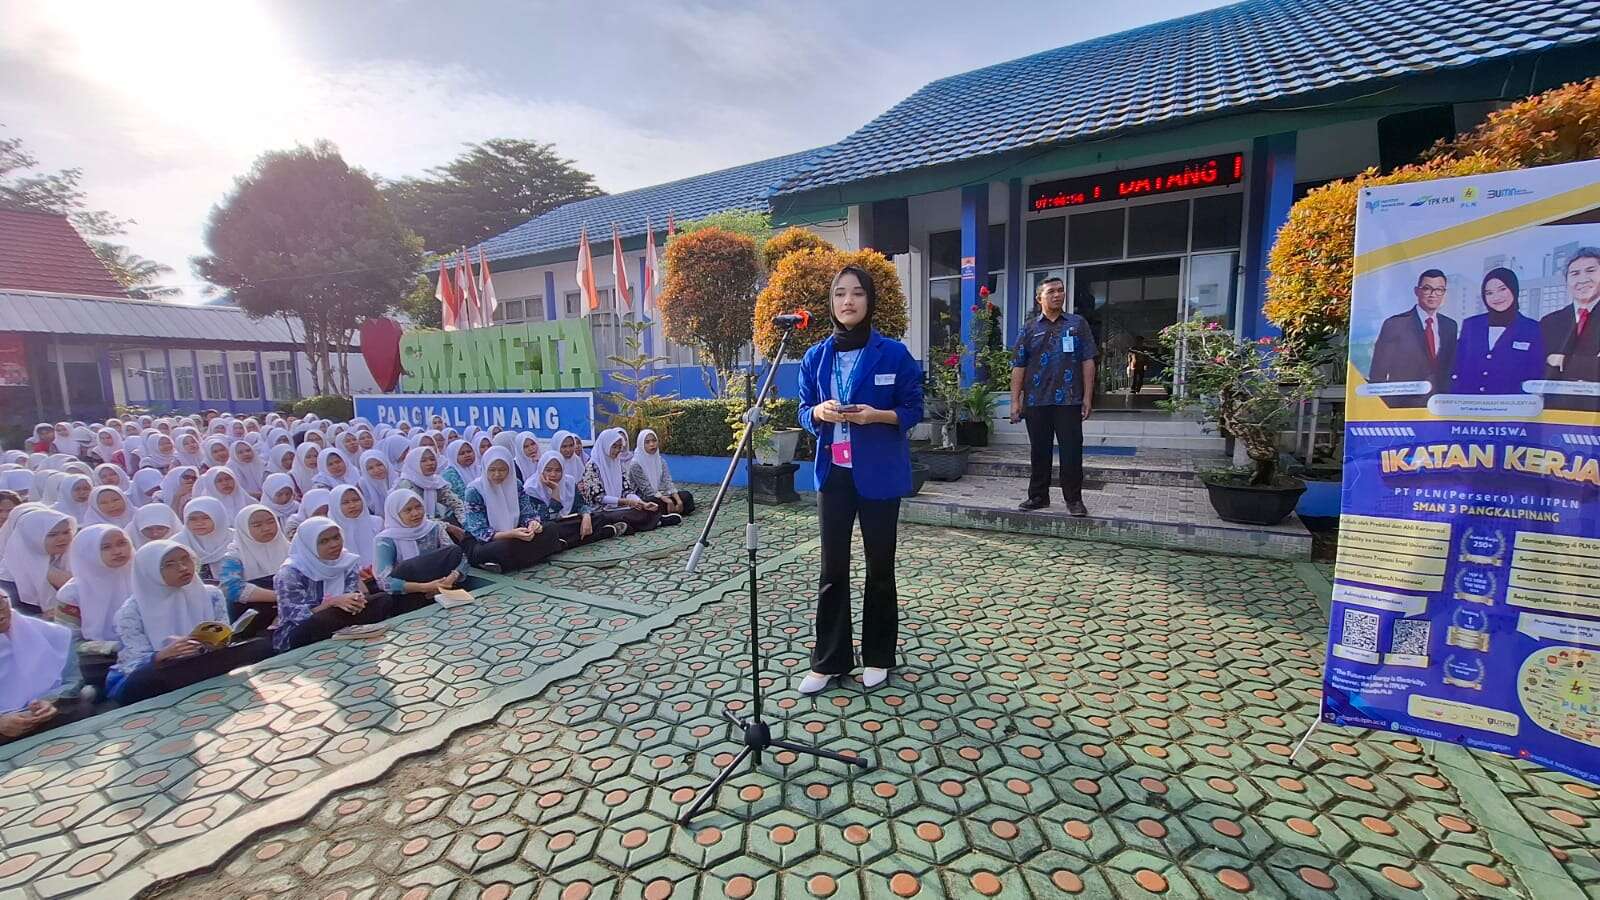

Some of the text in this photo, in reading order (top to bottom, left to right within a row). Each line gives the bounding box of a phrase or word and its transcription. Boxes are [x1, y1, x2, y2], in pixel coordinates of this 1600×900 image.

[1119, 160, 1217, 196] DATANG
[377, 405, 560, 430] PANGKALPINANG
[1451, 425, 1528, 437] MAHASISWA
[1381, 444, 1600, 483] IKATAN KERJA
[1395, 488, 1579, 510] PT PLN(Persero) di ITPLN
[1412, 501, 1560, 523] SMAN 3 PANGKALPINANG
[1473, 540, 1493, 549] 250+
[1561, 700, 1589, 713] PLN
